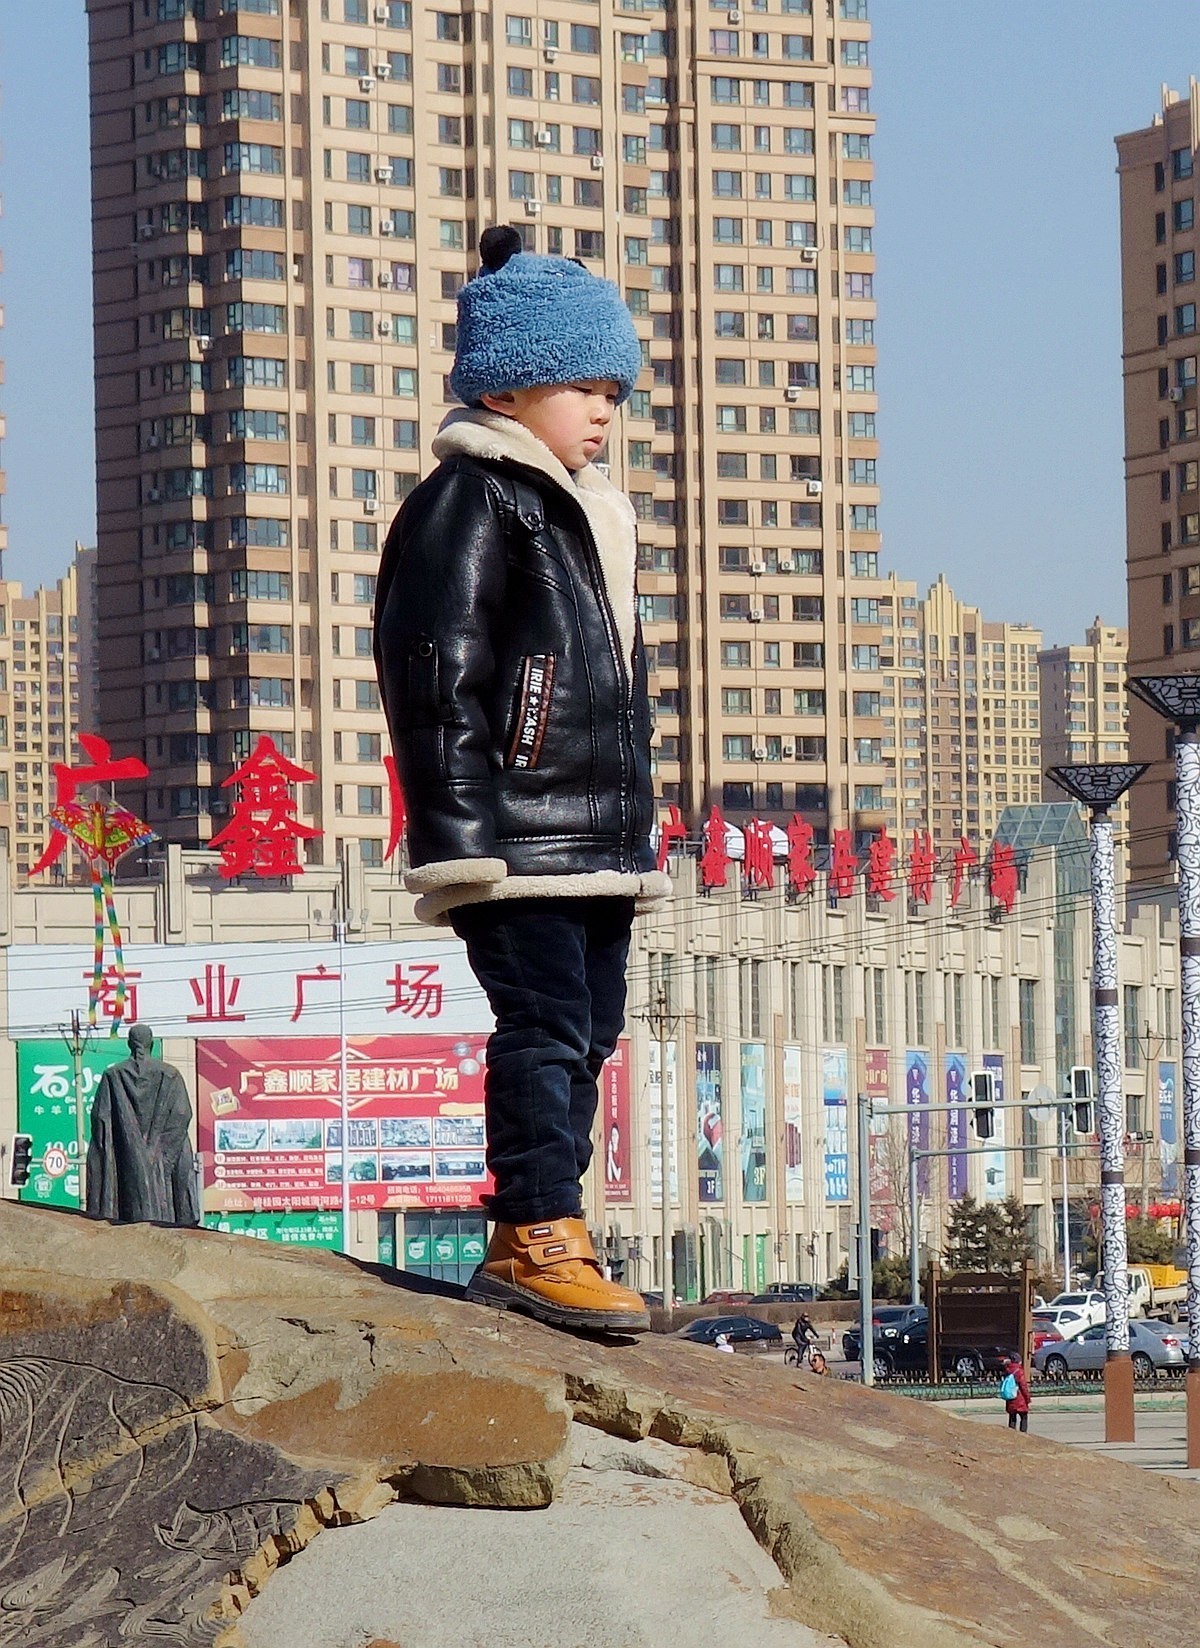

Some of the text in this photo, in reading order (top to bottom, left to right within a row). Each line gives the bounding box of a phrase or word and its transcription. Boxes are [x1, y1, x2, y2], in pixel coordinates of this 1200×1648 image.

[528, 667, 545, 695] IRIE
[656, 803, 1018, 915] 广鑫顺家居建材广场
[83, 963, 441, 1024] 商业广场
[239, 1066, 459, 1095] 广鑫顺家居建材广场
[48, 1156, 63, 1169] 70
